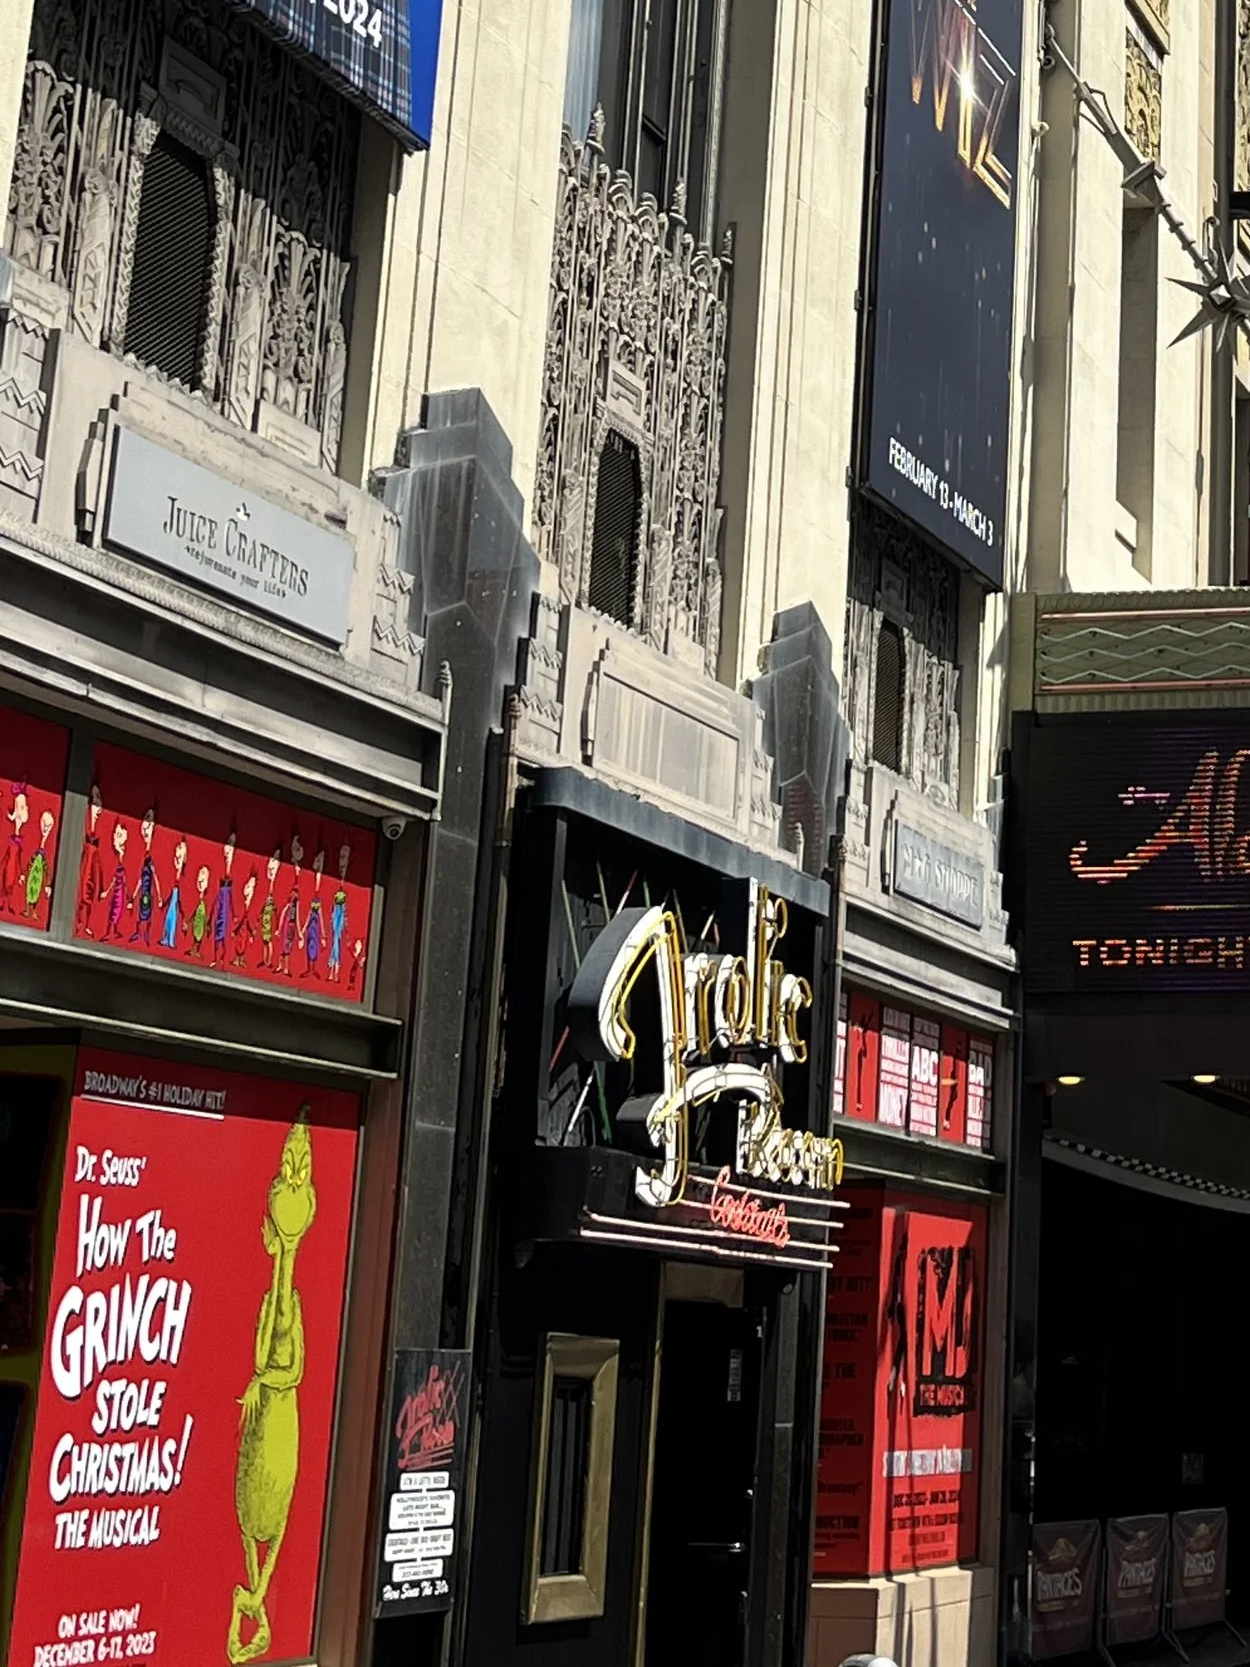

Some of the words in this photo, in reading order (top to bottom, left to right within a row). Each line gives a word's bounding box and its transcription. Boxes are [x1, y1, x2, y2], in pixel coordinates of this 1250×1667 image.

[889, 436, 939, 501] FEBRUARY
[988, 520, 994, 547] 3
[163, 495, 218, 549] JUICE
[224, 517, 309, 597] CRAFTERS
[84, 1070, 148, 1100] BROADWAY'S
[148, 1081, 163, 1101] #1
[163, 1083, 205, 1107] HOLIDAY
[205, 1089, 227, 1110] HIT!
[911, 1045, 939, 1086] ABC
[74, 1145, 96, 1182] Dr.
[50, 1271, 192, 1400] GRINCH
[921, 1246, 973, 1379] MJ
[92, 1378, 168, 1435] STOLE
[49, 1413, 194, 1504] CHRISTMAS!
[54, 1509, 89, 1551] THE
[87, 1505, 161, 1549] MUSICAL
[57, 1613, 77, 1639] ON
[77, 1609, 107, 1636] SALE
[108, 1602, 141, 1633] NOW!
[33, 1638, 96, 1667] DECEMBER
